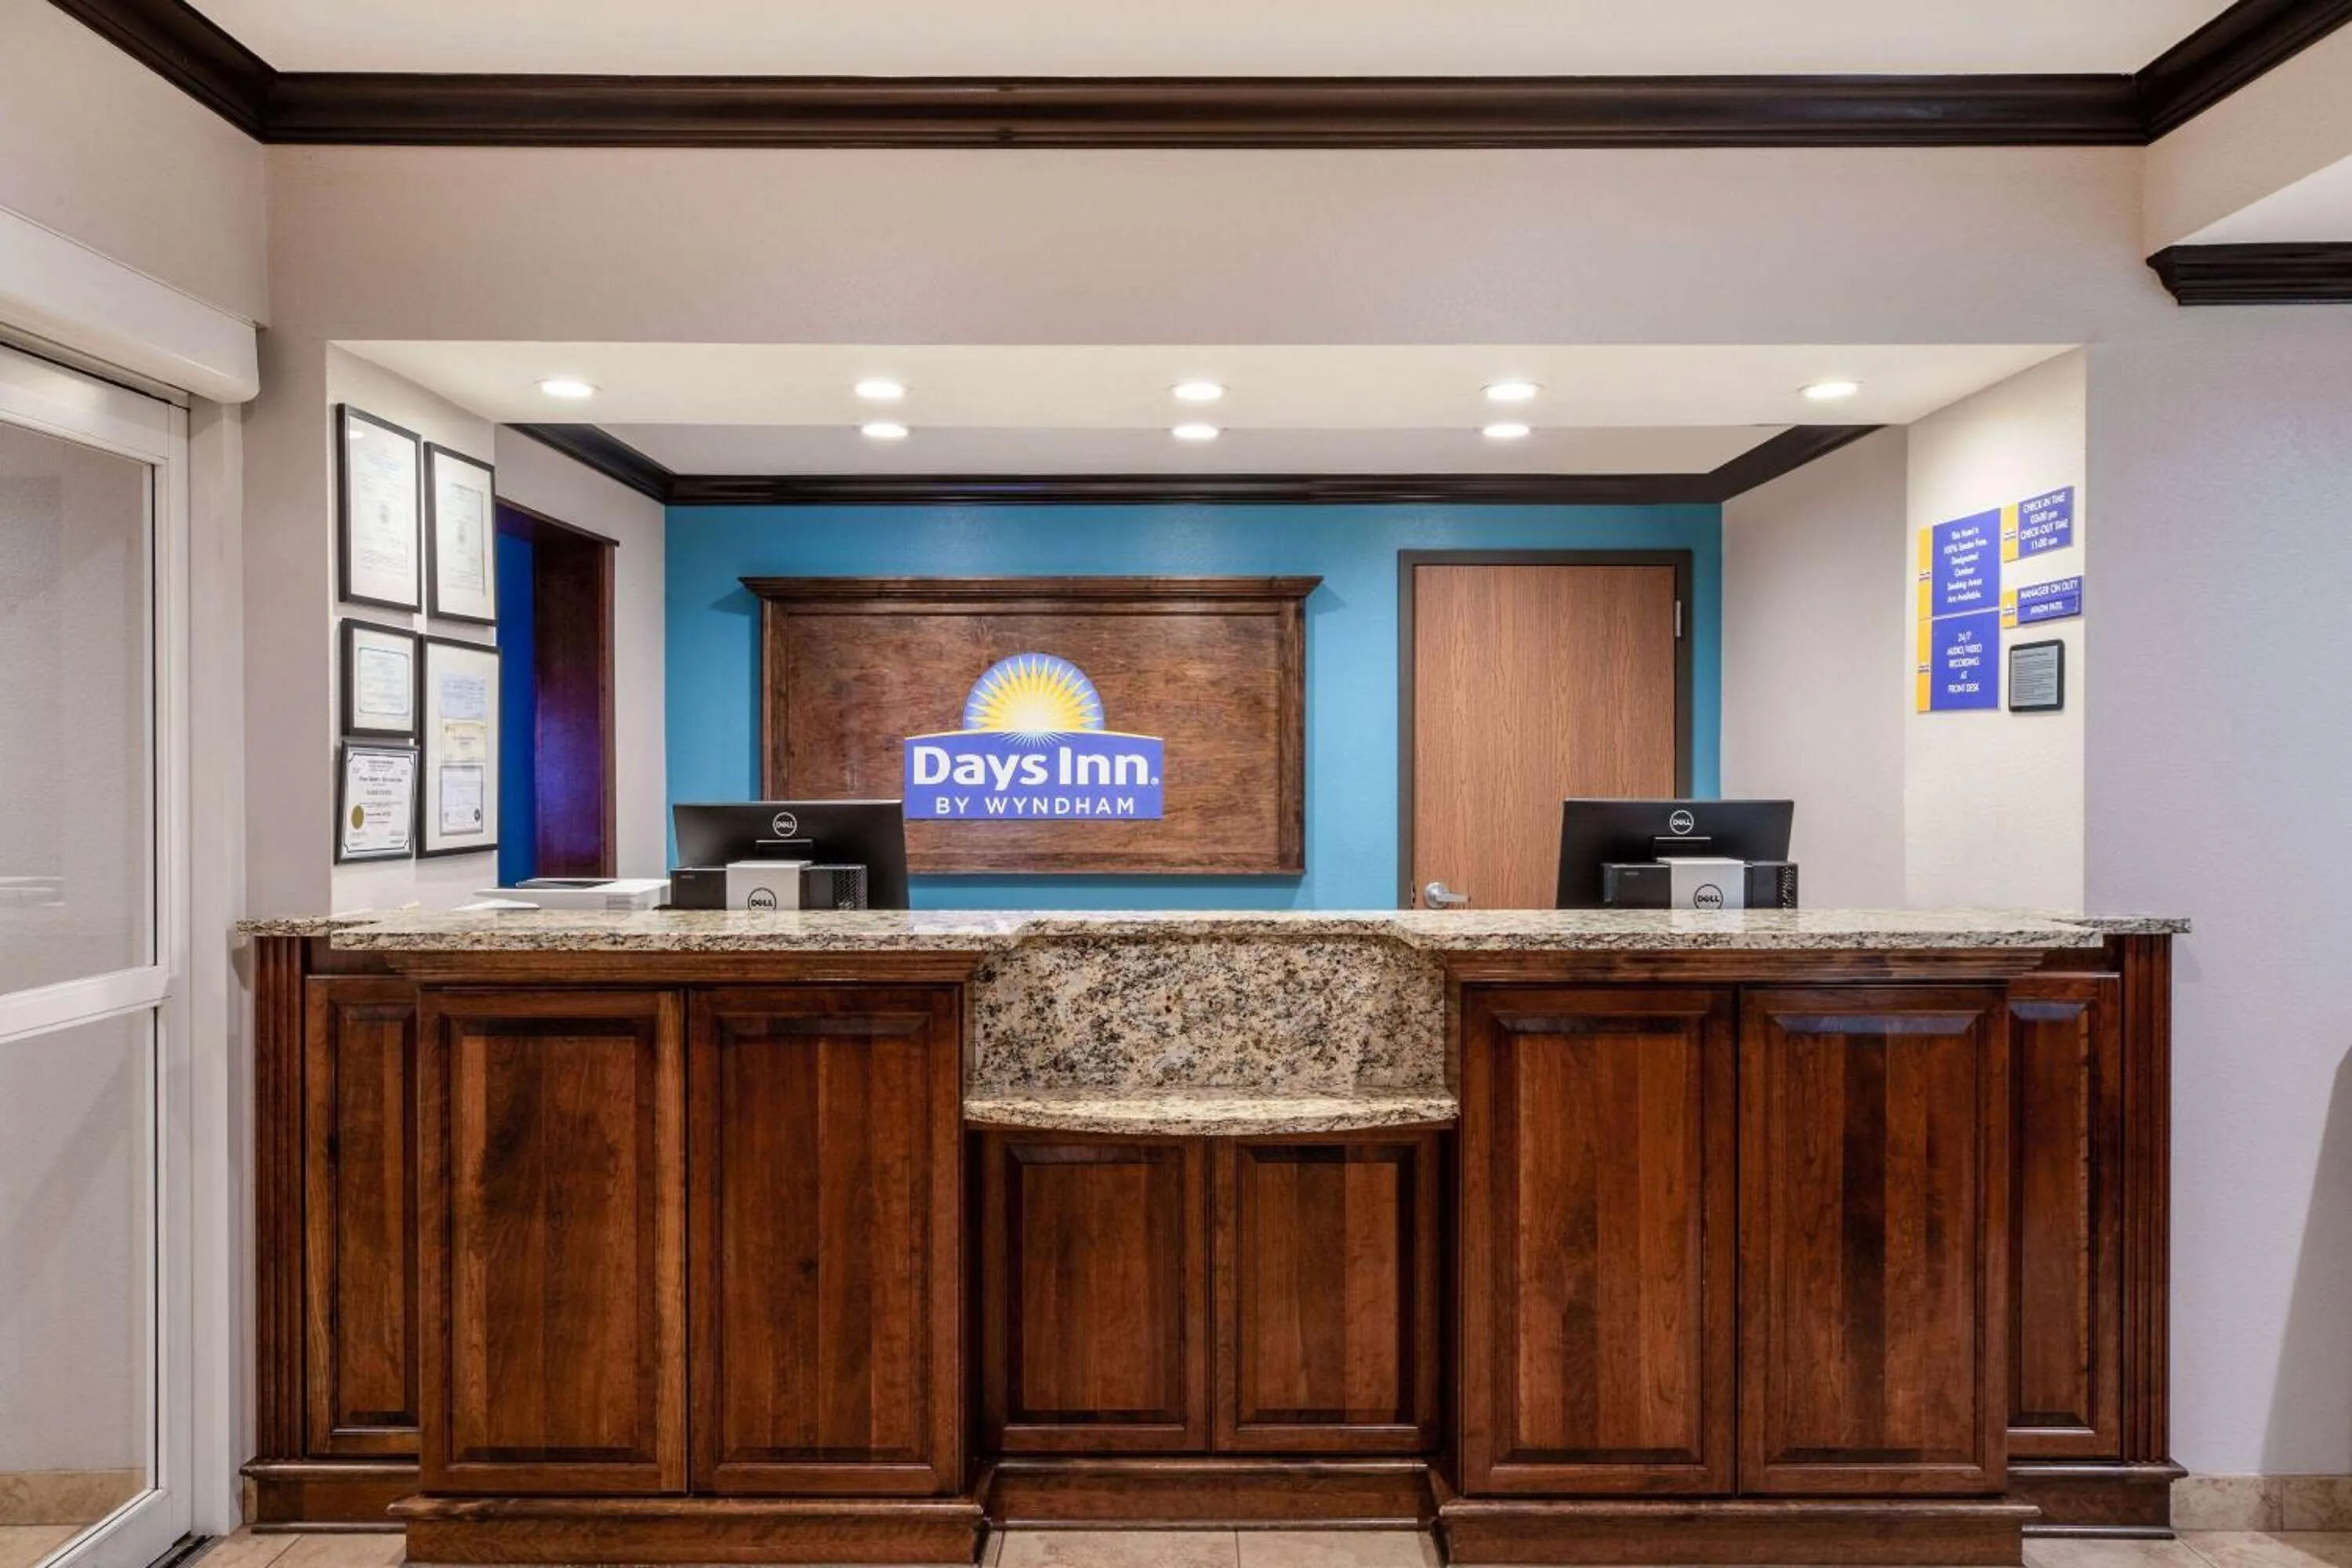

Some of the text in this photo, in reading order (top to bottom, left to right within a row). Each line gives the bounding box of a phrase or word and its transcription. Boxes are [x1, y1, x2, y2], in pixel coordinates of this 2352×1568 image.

[2055, 518, 2069, 530] TIME
[2020, 579, 2078, 599] MANAGER ON DUTY
[913, 746, 1149, 791] Days Inn
[935, 797, 1134, 815] BY WYNDHAM
[775, 820, 794, 829] DELL
[750, 898, 773, 907] DELL
[1697, 895, 1720, 903] DELL
